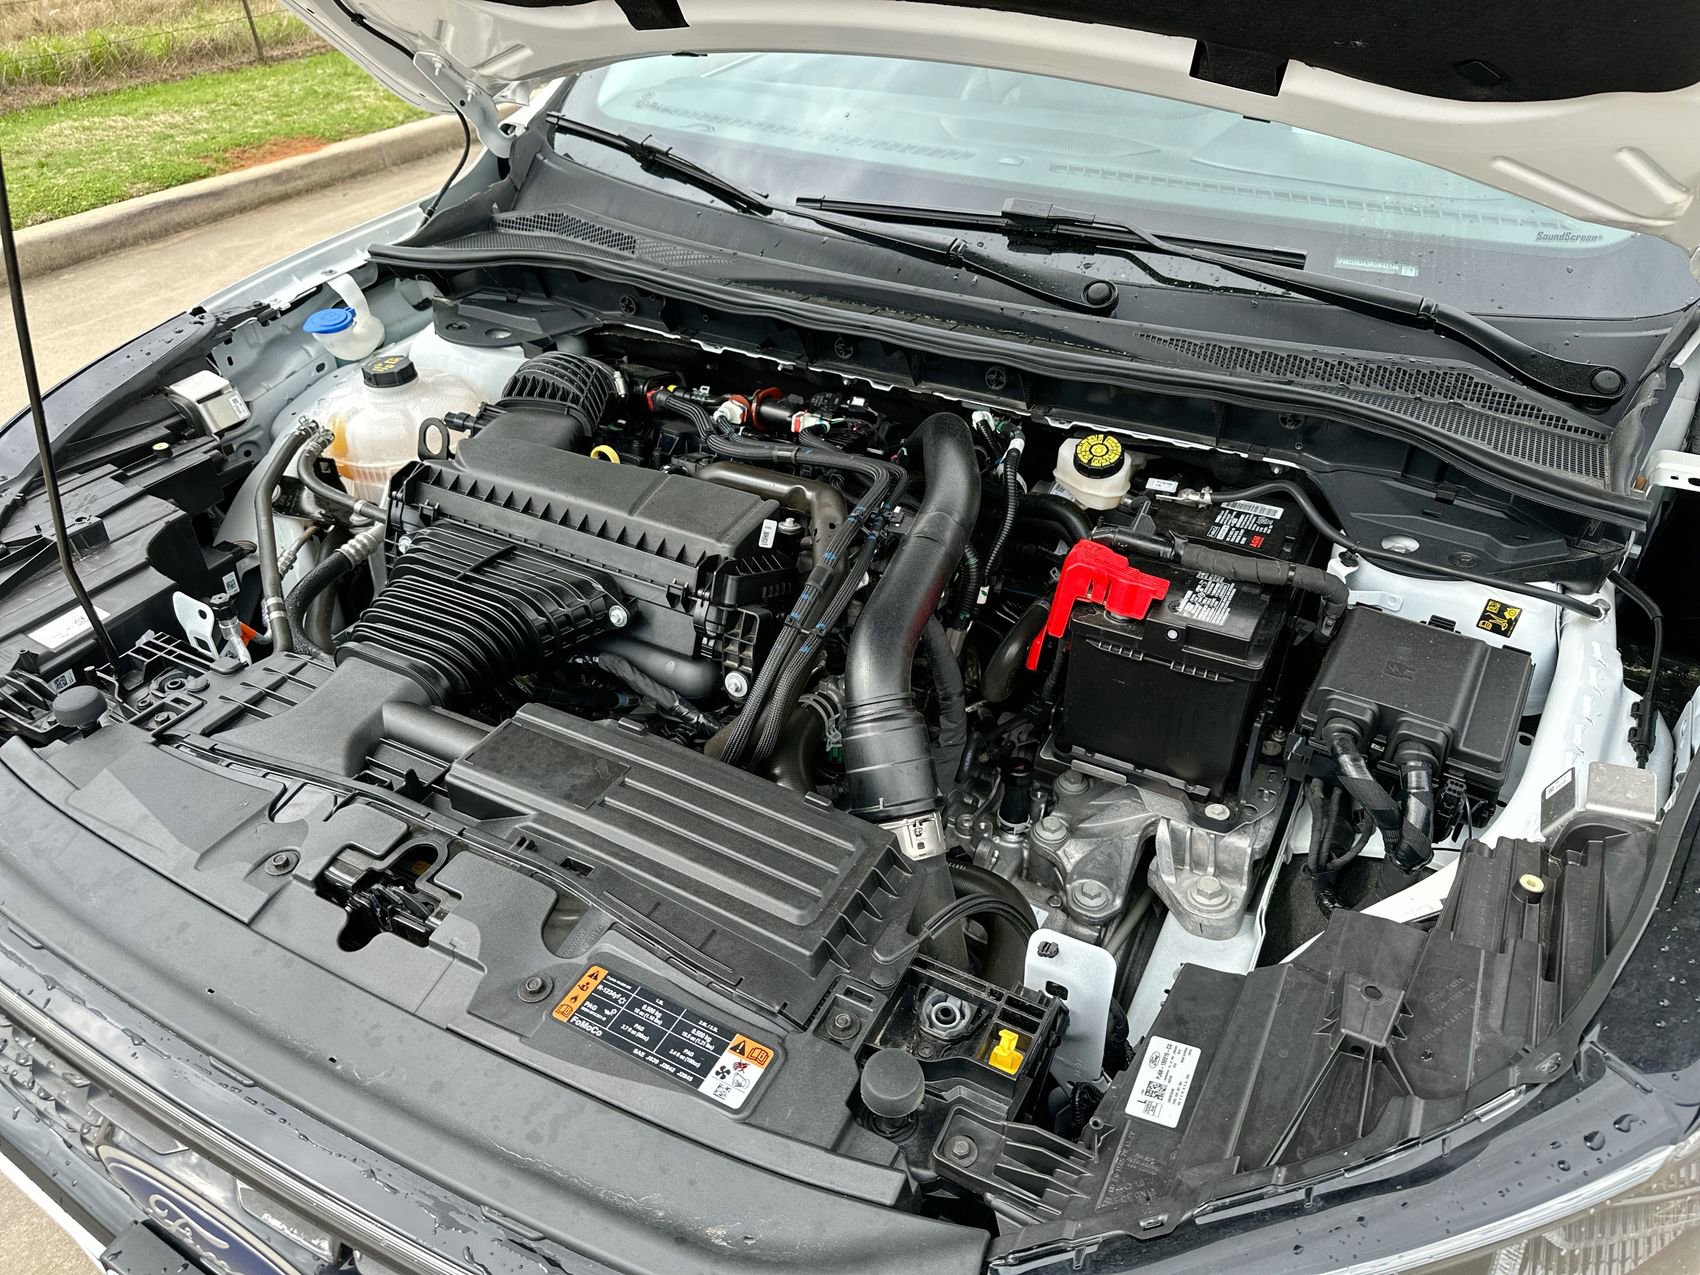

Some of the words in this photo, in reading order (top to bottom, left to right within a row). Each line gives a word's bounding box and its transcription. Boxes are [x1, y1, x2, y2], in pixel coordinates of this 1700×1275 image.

[597, 985, 621, 999] R-1234yf
[584, 1001, 598, 1011] PAG
[570, 1016, 603, 1036] FoMoCo
